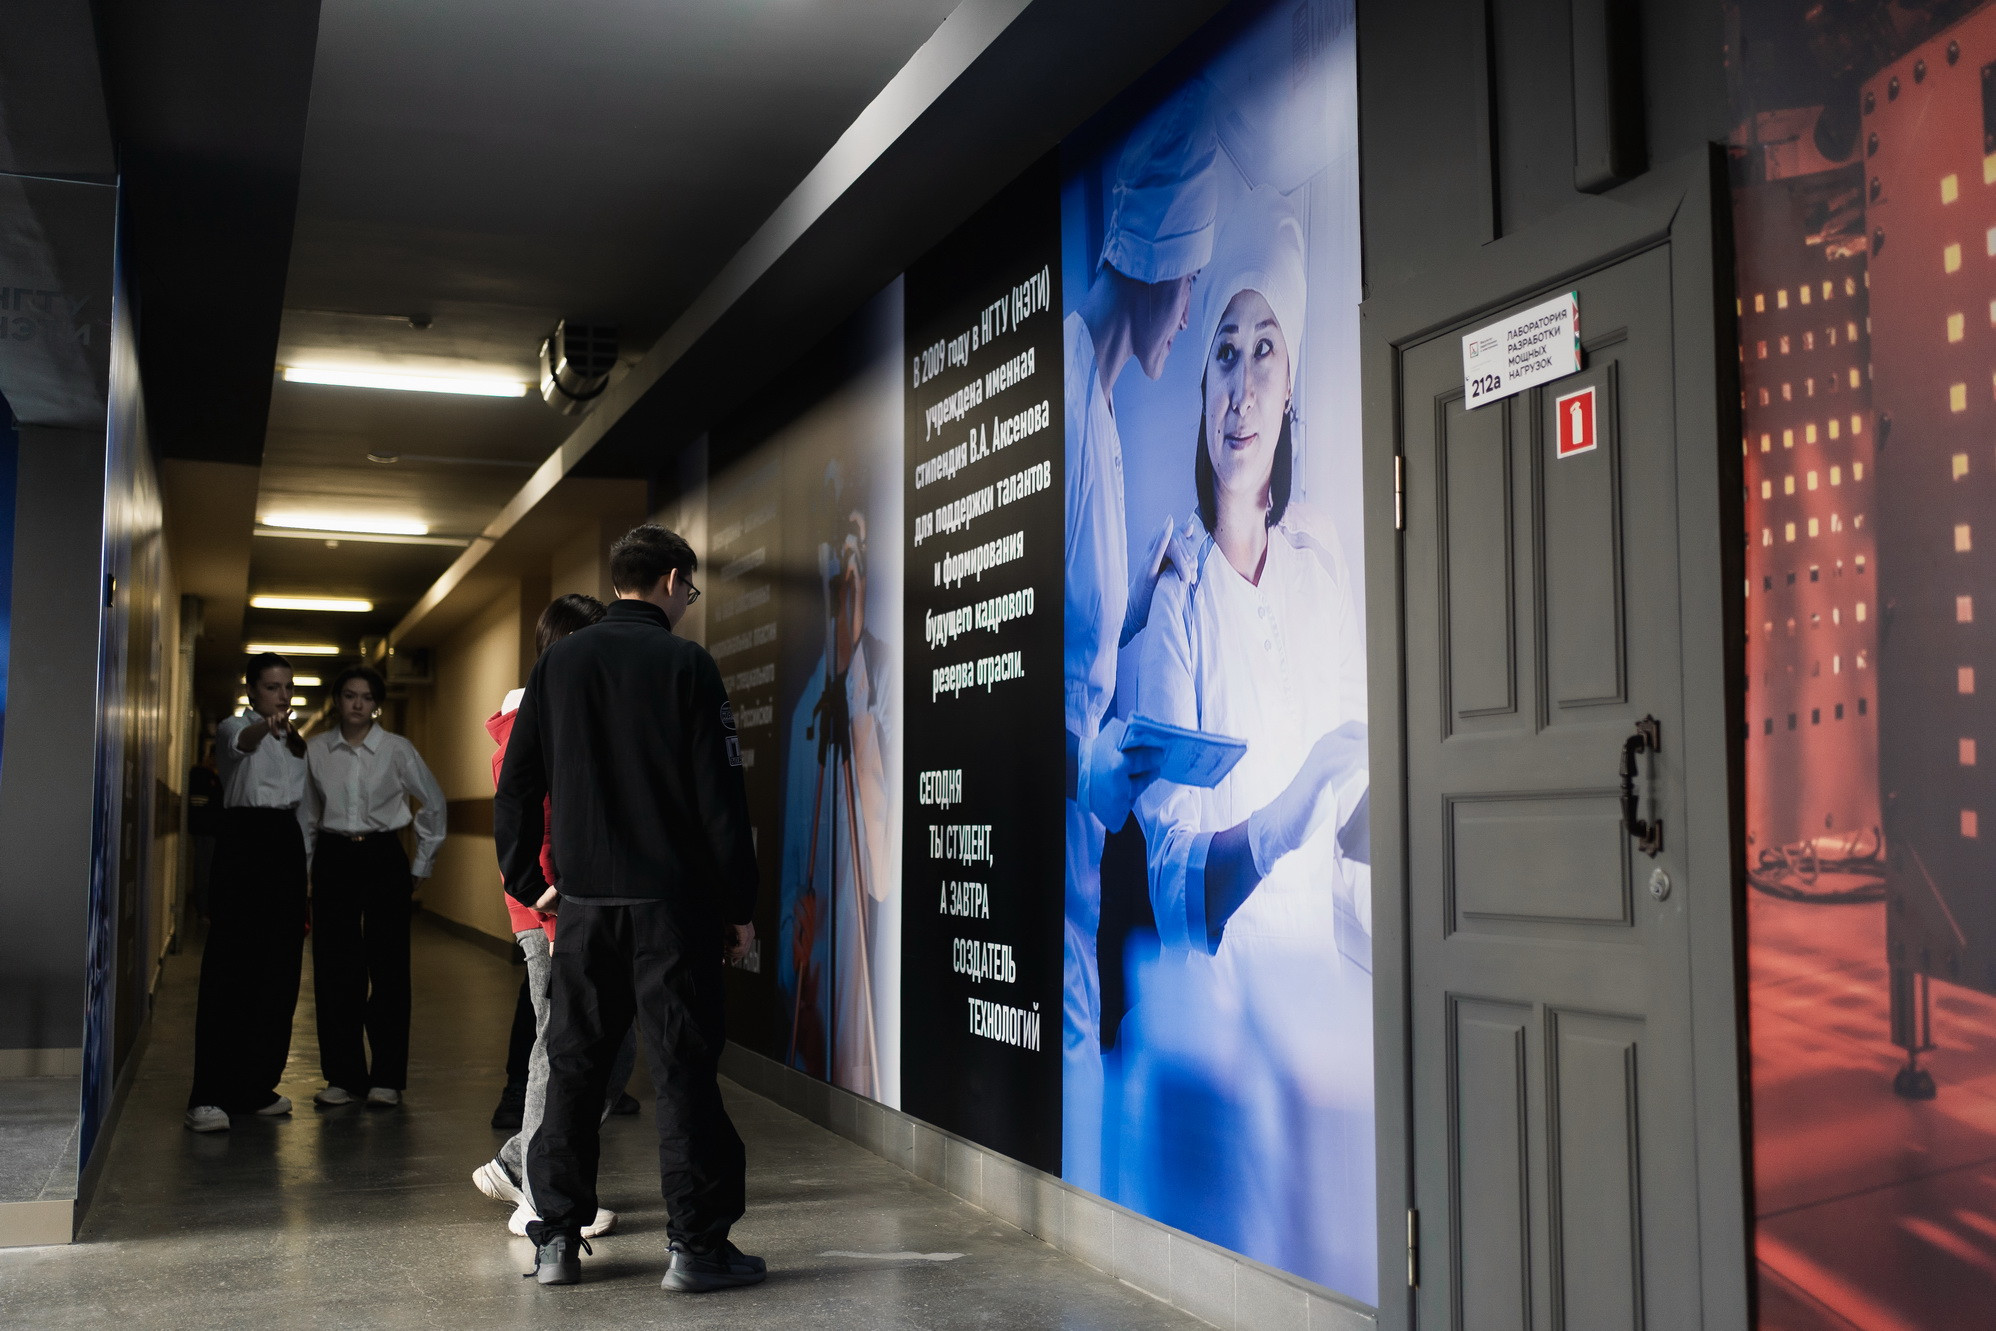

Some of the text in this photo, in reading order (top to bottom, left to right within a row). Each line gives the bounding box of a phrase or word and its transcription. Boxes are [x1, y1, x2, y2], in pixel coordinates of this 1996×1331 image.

[913, 264, 1051, 389] В 2009 году в НГТУ (НЭТИ)
[1506, 309, 1568, 342] ЛАБОРАТОРИЯ
[1507, 325, 1561, 354] РАЗРАБОТКИ
[1508, 344, 1548, 367] МОЩНЫХ
[1508, 356, 1553, 381] НАГРУЗОК
[925, 346, 1035, 442] учреждена именная
[1471, 374, 1502, 398] 212а
[915, 399, 1050, 490] стипендия В.А. Аксенова
[914, 460, 1052, 548] для поддержки талантов
[933, 530, 1024, 590] и формирования
[925, 587, 1035, 650] будущего кадрового
[932, 650, 1025, 704] резерва отрасли.
[919, 768, 963, 810] СЕГОДНЯ
[929, 825, 994, 868] ТЫ СТУДЕНТ,
[940, 880, 990, 919] А ЗАВТРА
[953, 937, 1017, 984] СОЗДАТЕЛЬ
[968, 997, 1041, 1052] ТЕХНОЛОГИЙ
